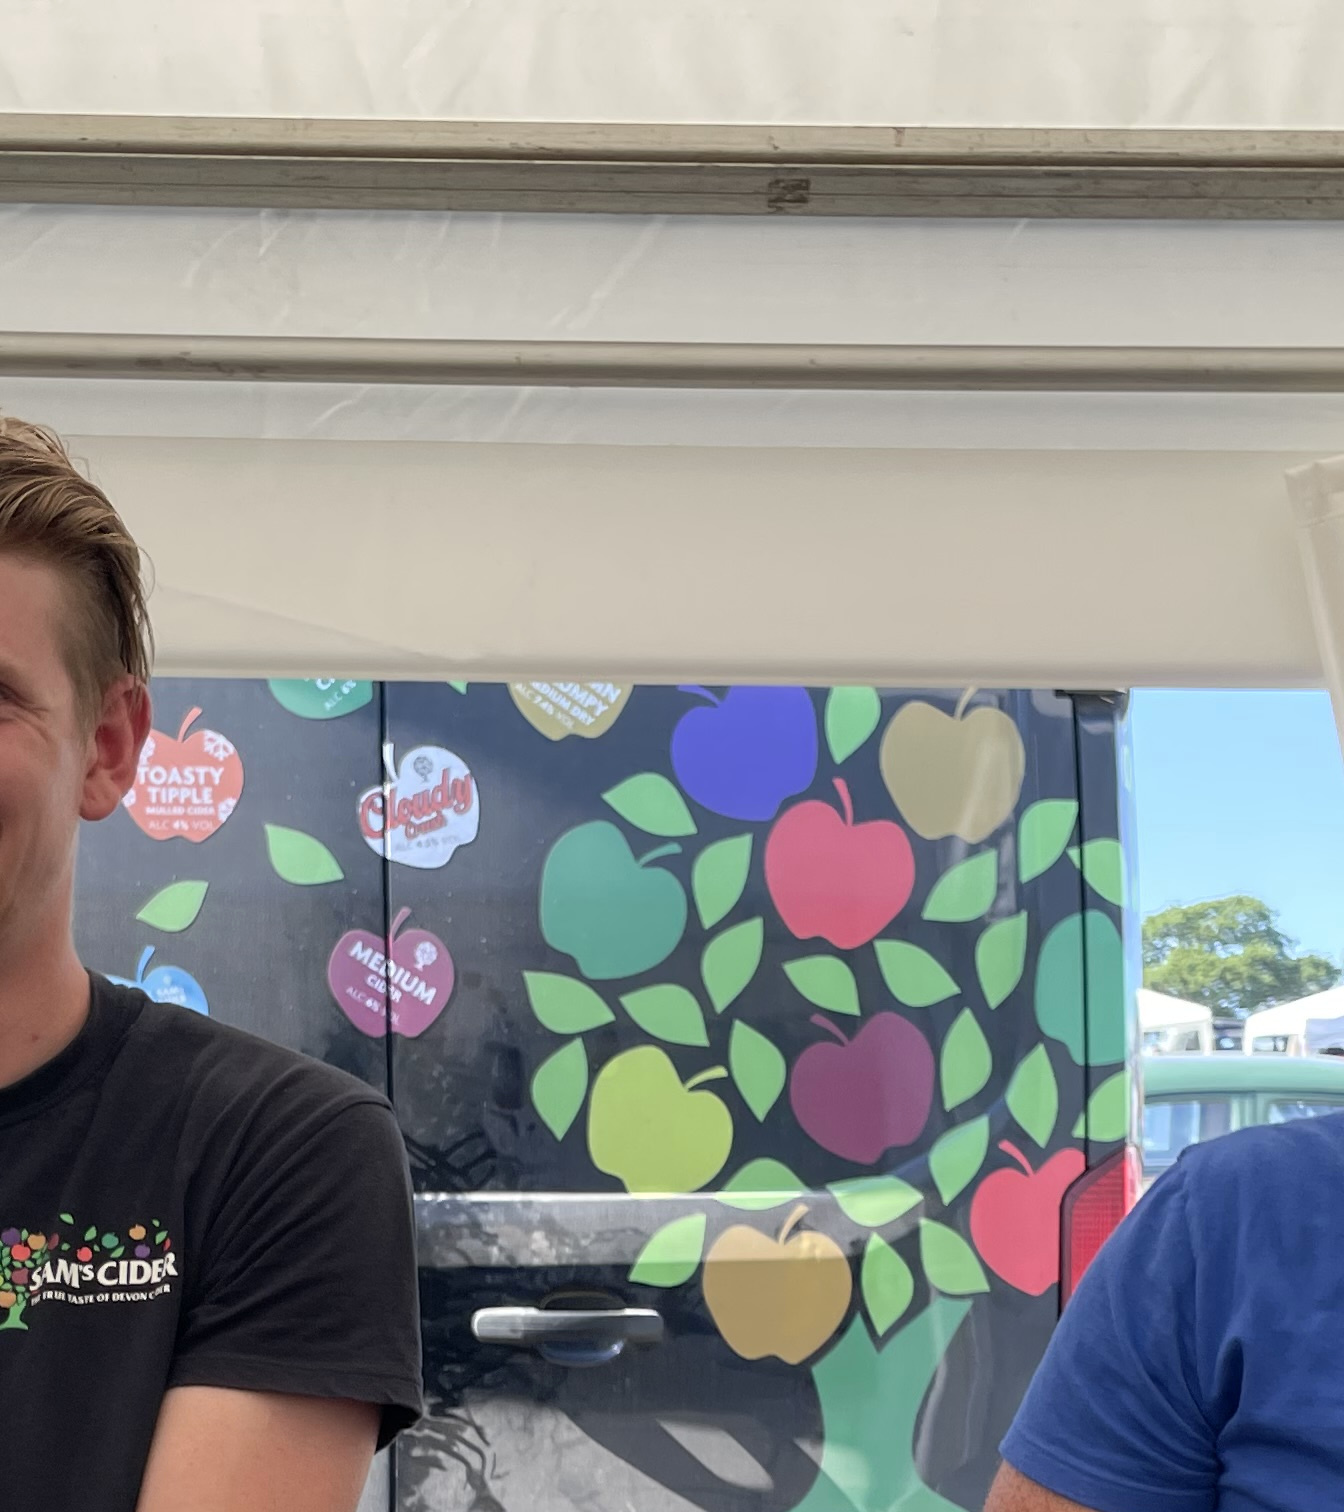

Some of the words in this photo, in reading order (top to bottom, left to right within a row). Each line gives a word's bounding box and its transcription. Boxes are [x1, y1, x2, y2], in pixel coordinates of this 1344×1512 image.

[138, 766, 224, 785] TOASTY
[147, 787, 213, 804] TIPPLE
[360, 768, 473, 840] Cloudy
[349, 941, 437, 1005] MEDIUM
[97, 1252, 178, 1286] CIDER
[67, 1294, 95, 1305] TASTE
[97, 1292, 110, 1303] OF
[112, 1291, 147, 1302] DEVON
